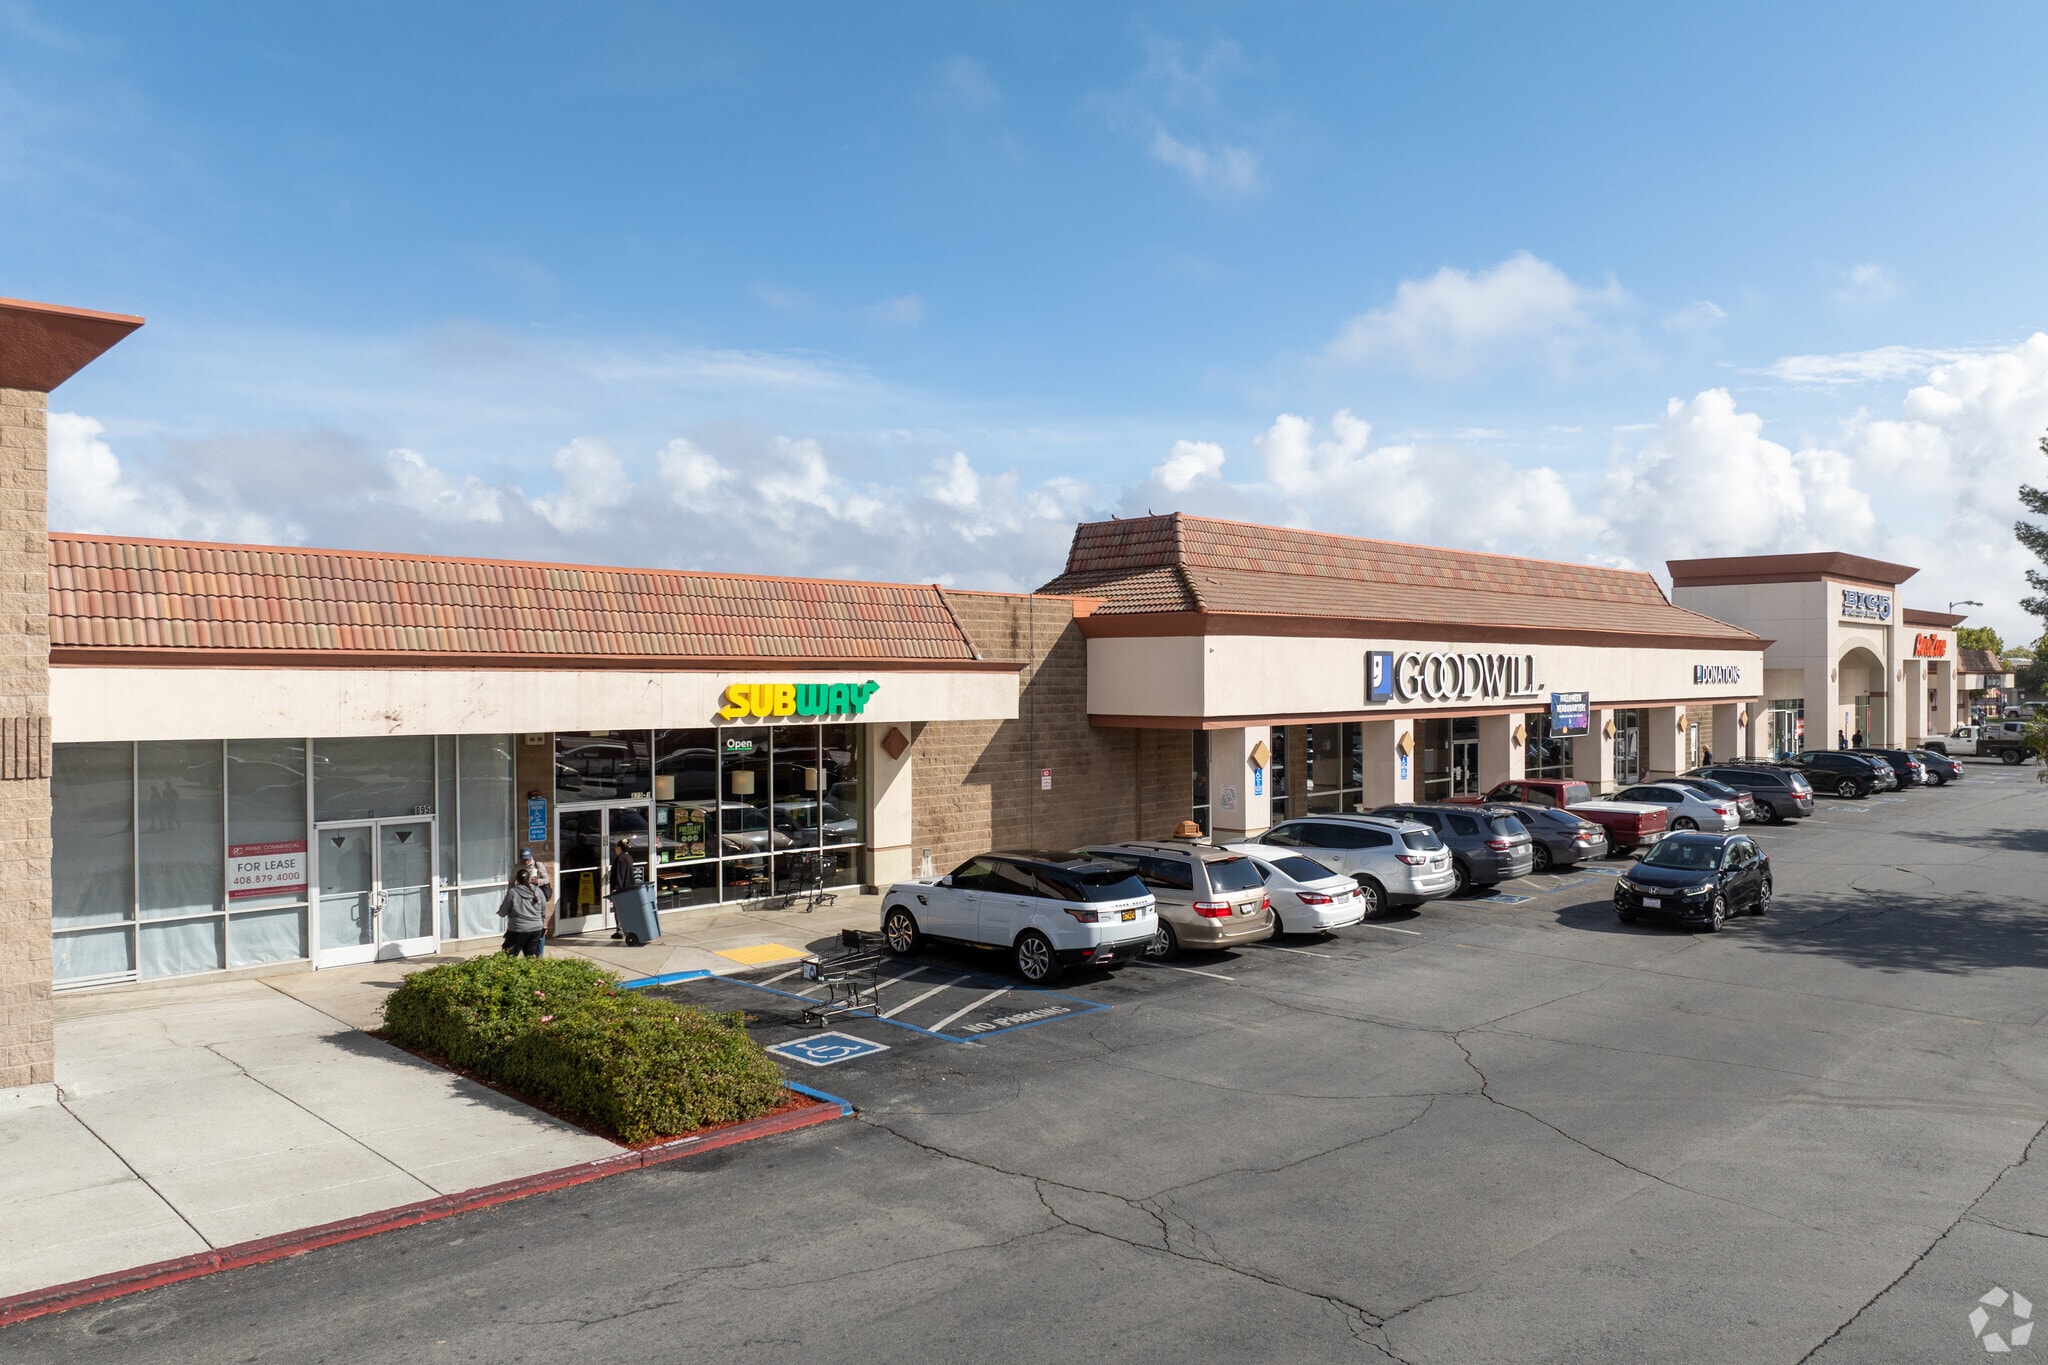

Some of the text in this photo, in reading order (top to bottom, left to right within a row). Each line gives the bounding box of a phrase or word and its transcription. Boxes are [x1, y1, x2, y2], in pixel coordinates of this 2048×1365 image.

[1843, 590, 1878, 610] BIG
[1879, 594, 1891, 620] 5
[1914, 633, 1947, 657] AutoZone
[1397, 652, 1545, 699] GOODWILL
[1703, 665, 1740, 684] DONATIONS
[717, 680, 880, 720] SUBWAY
[1556, 703, 1586, 713] HEADQUARTERS
[727, 738, 752, 750] Open
[415, 805, 430, 815] 895
[237, 859, 296, 872] FOR LEASE
[233, 872, 300, 885] 408.879.4000
[962, 1005, 1071, 1033] NO PARKING
